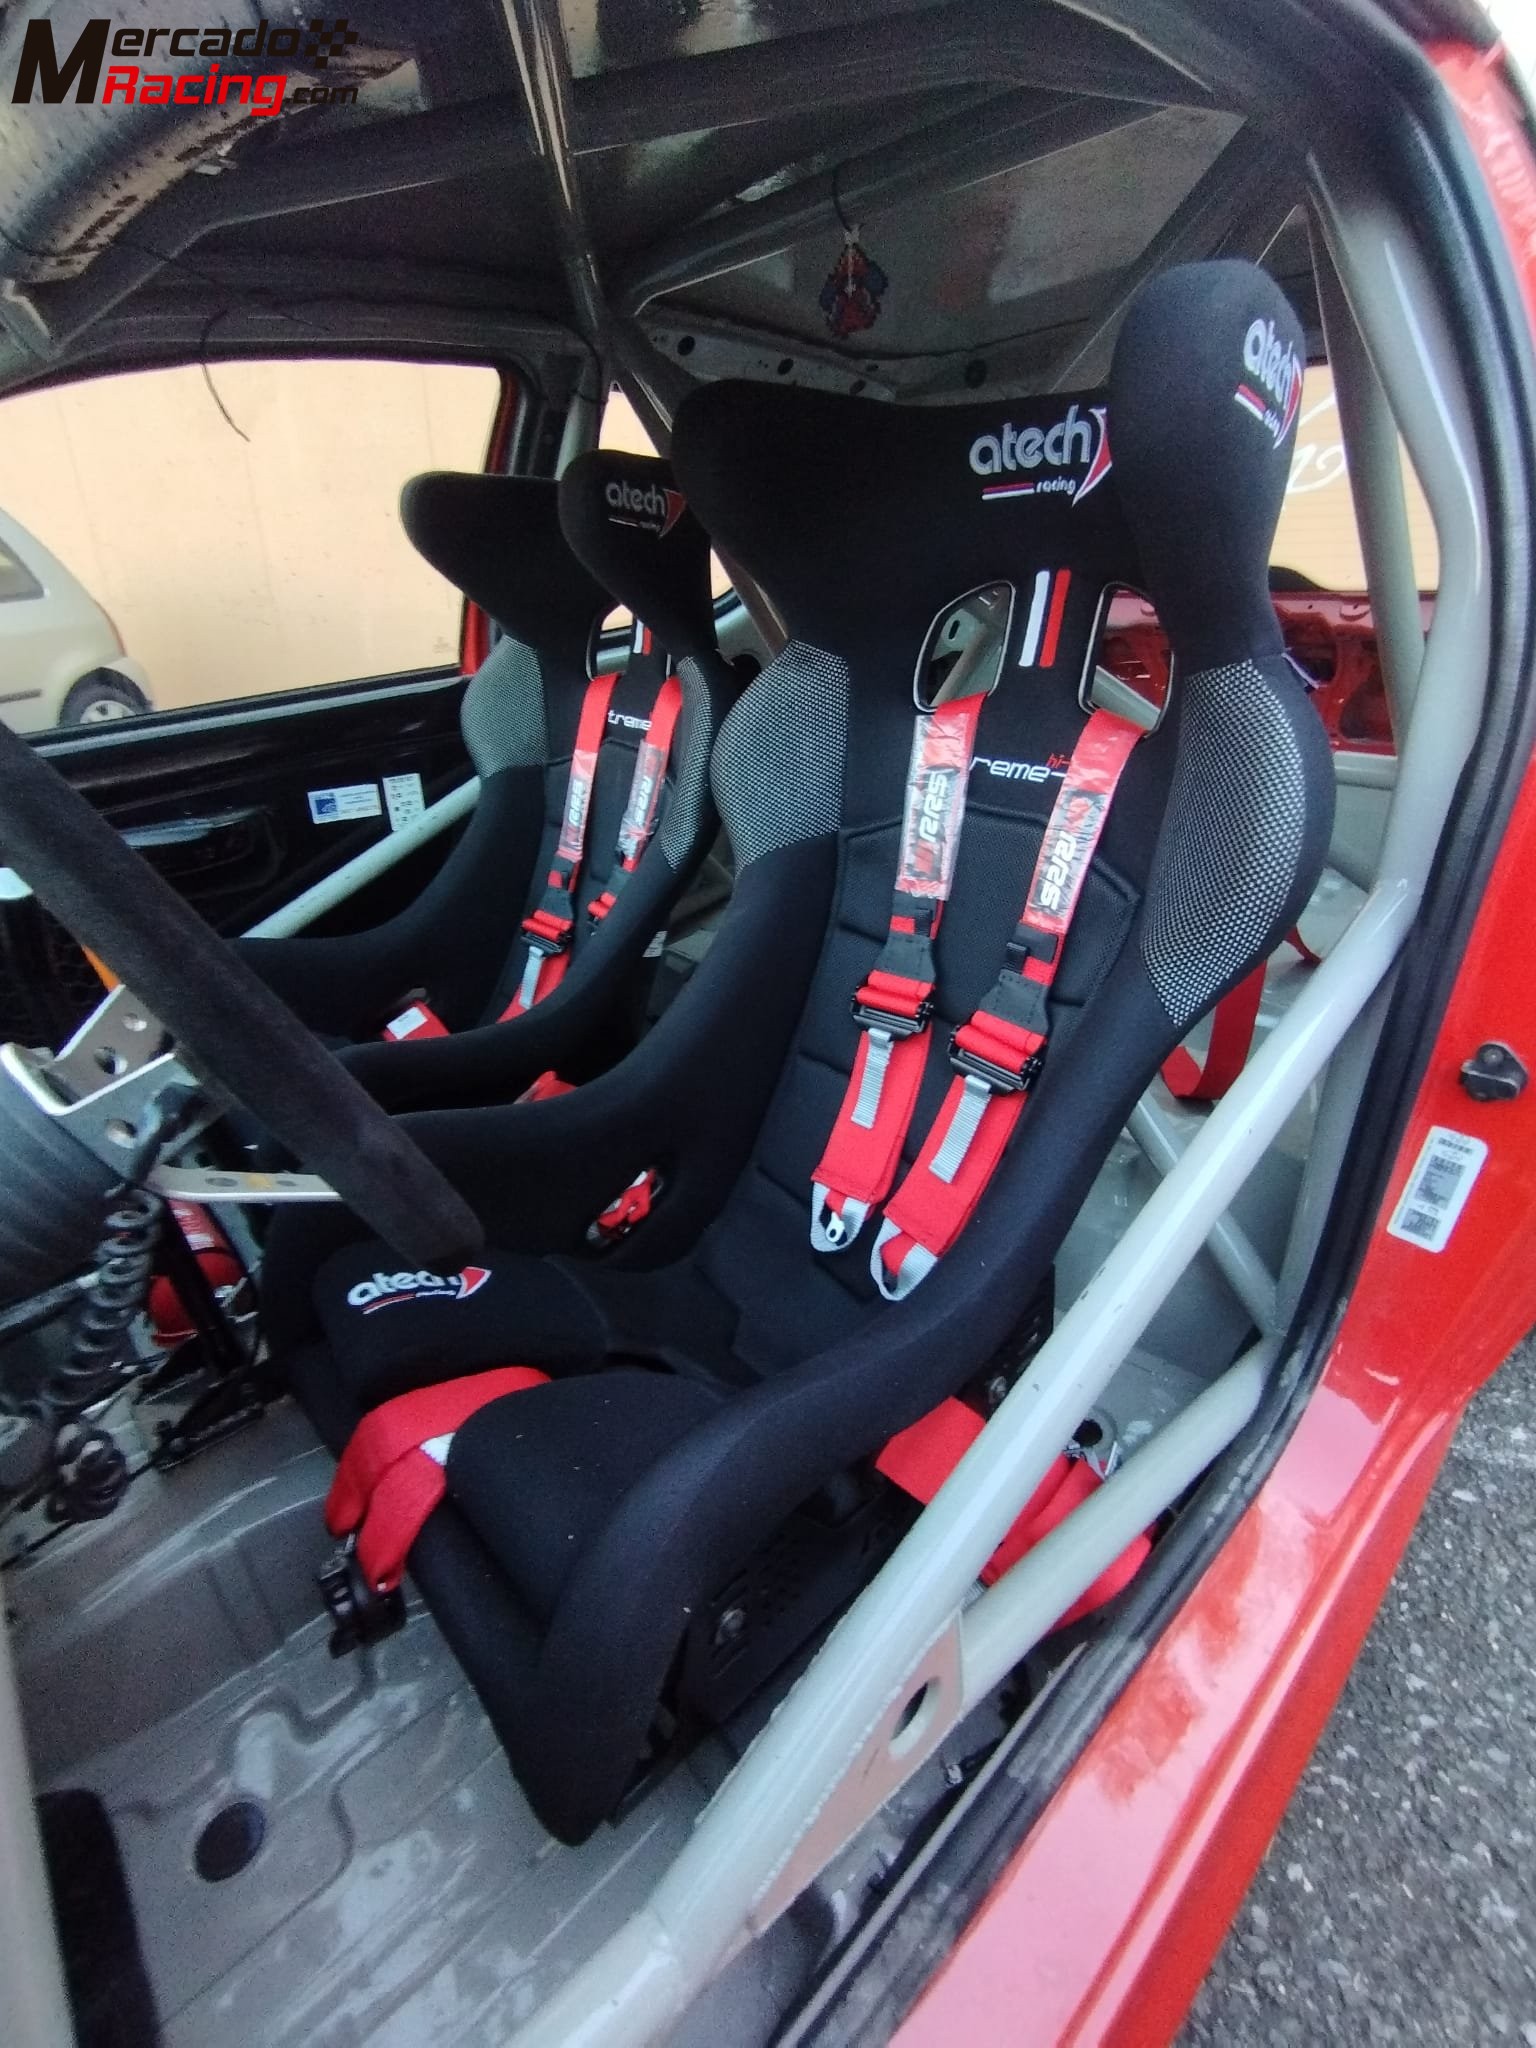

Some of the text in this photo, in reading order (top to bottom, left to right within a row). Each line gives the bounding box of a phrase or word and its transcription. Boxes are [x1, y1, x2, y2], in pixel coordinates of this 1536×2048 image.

[969, 404, 1093, 476] atech
[606, 481, 666, 517] atech
[1036, 475, 1076, 496] racing
[919, 771, 946, 842] RRS
[1041, 831, 1075, 910] RRS
